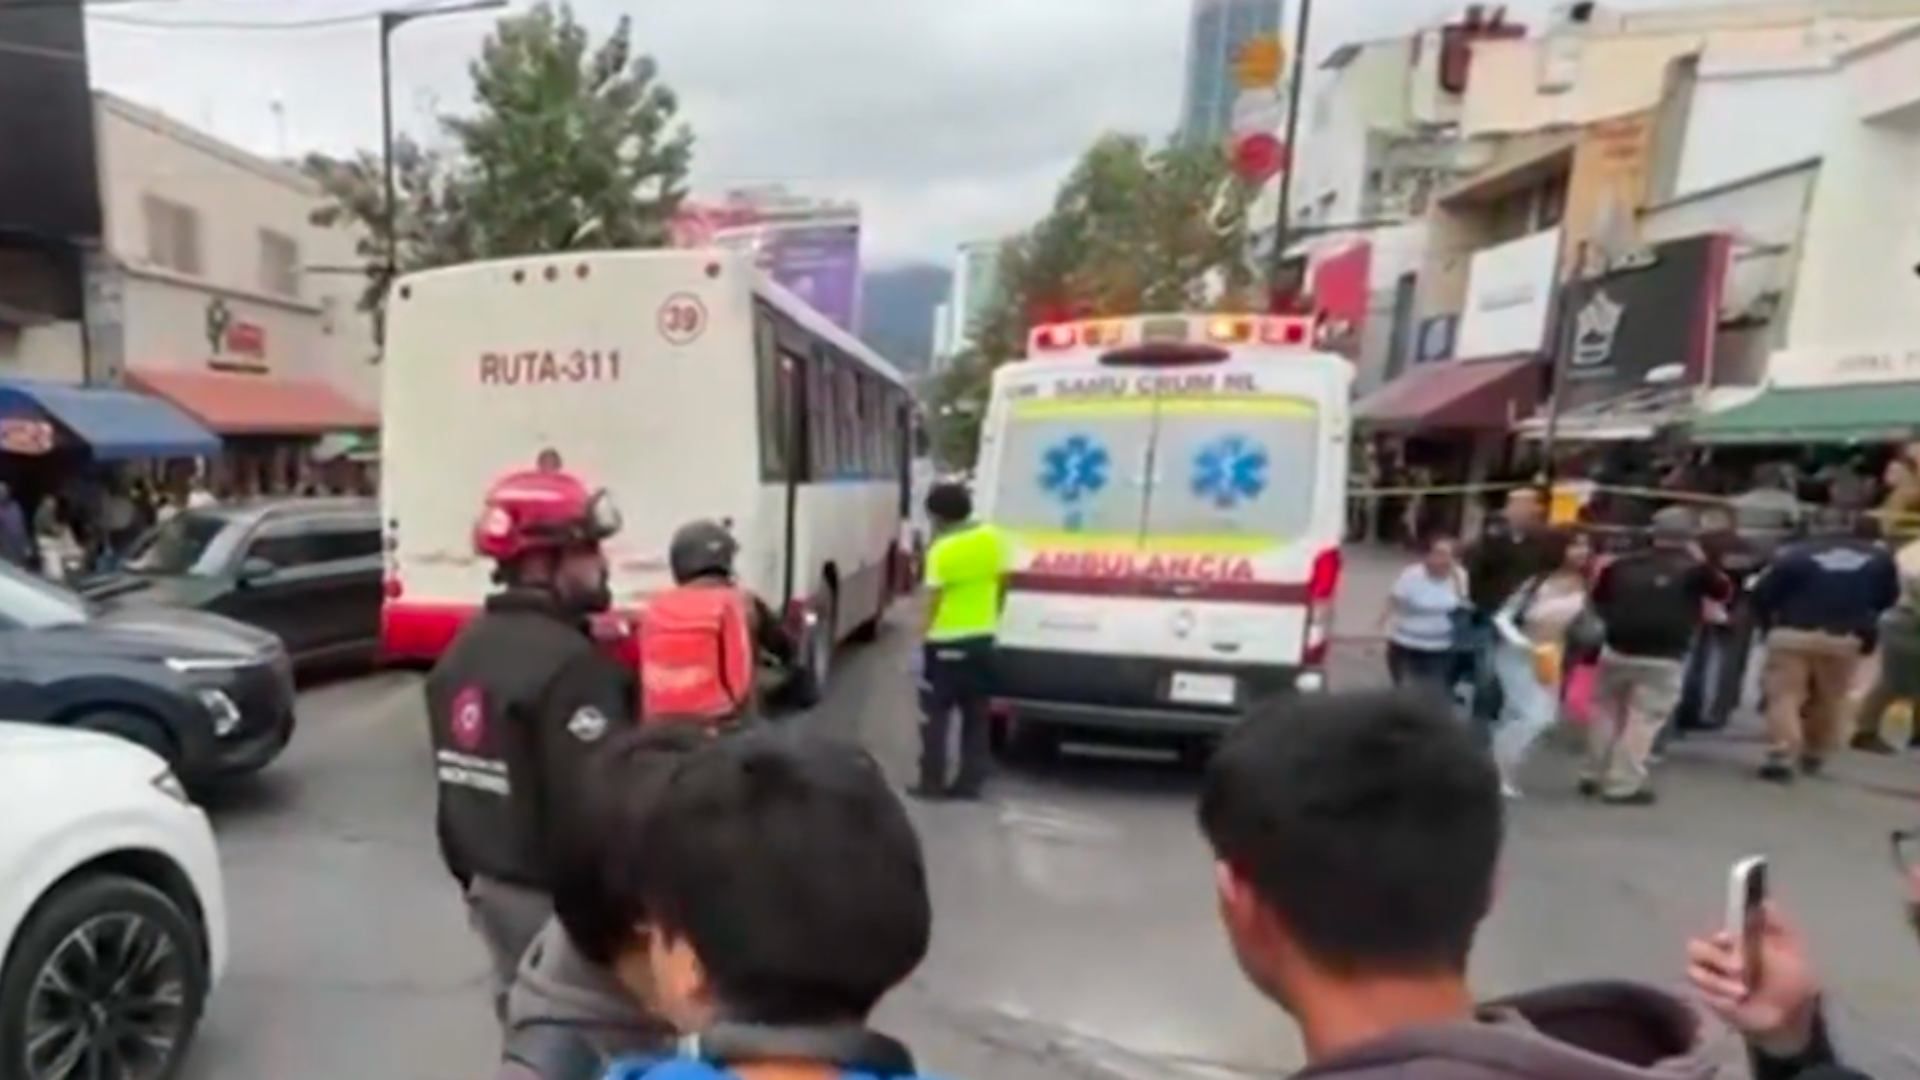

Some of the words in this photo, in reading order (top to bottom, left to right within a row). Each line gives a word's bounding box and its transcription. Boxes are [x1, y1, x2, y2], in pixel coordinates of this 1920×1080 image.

[667, 305, 699, 332] 39
[480, 351, 620, 385] RUTA-311
[1054, 375, 1127, 398] SAMU
[1031, 552, 1255, 581] AMBULANCIA
